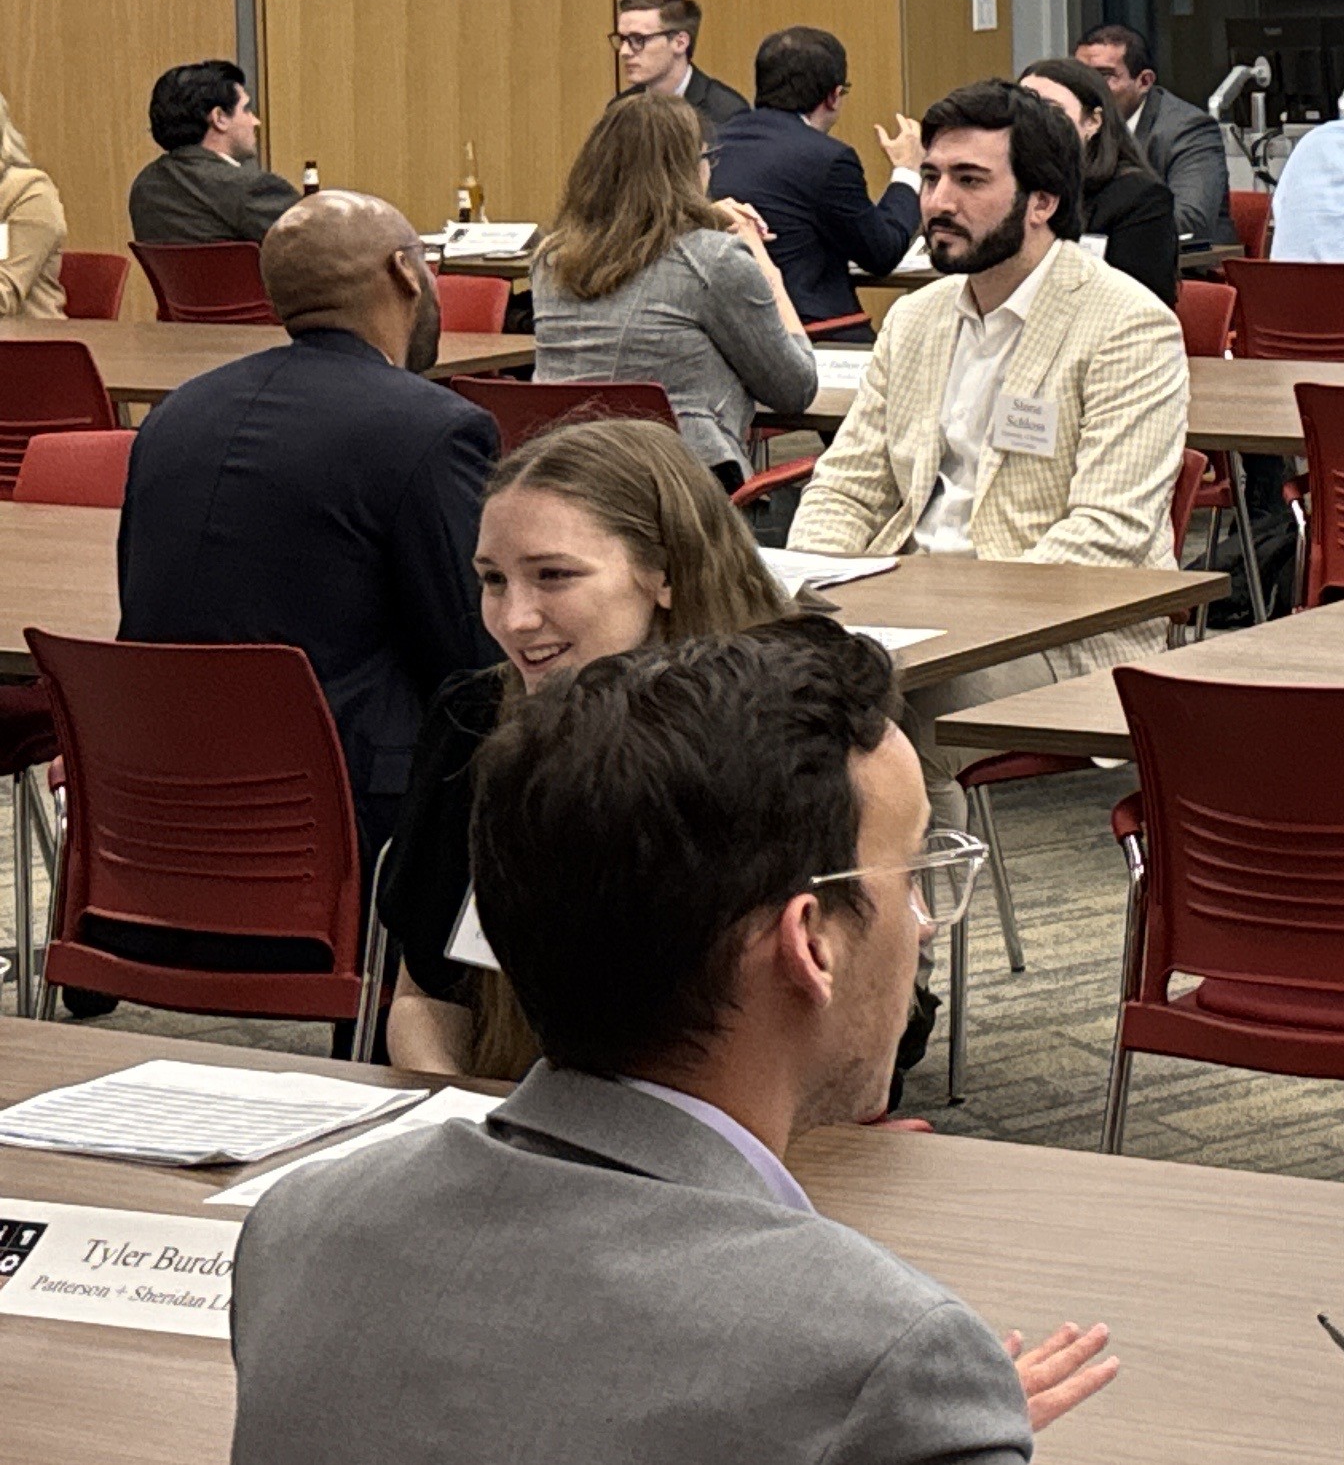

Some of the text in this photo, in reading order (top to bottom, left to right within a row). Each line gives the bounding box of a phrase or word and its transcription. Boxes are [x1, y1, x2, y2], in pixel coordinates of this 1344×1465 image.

[82, 1238, 234, 1277] Tyler Burdo
[30, 1274, 111, 1299] Patterson
[128, 1285, 206, 1306] Sheridan
